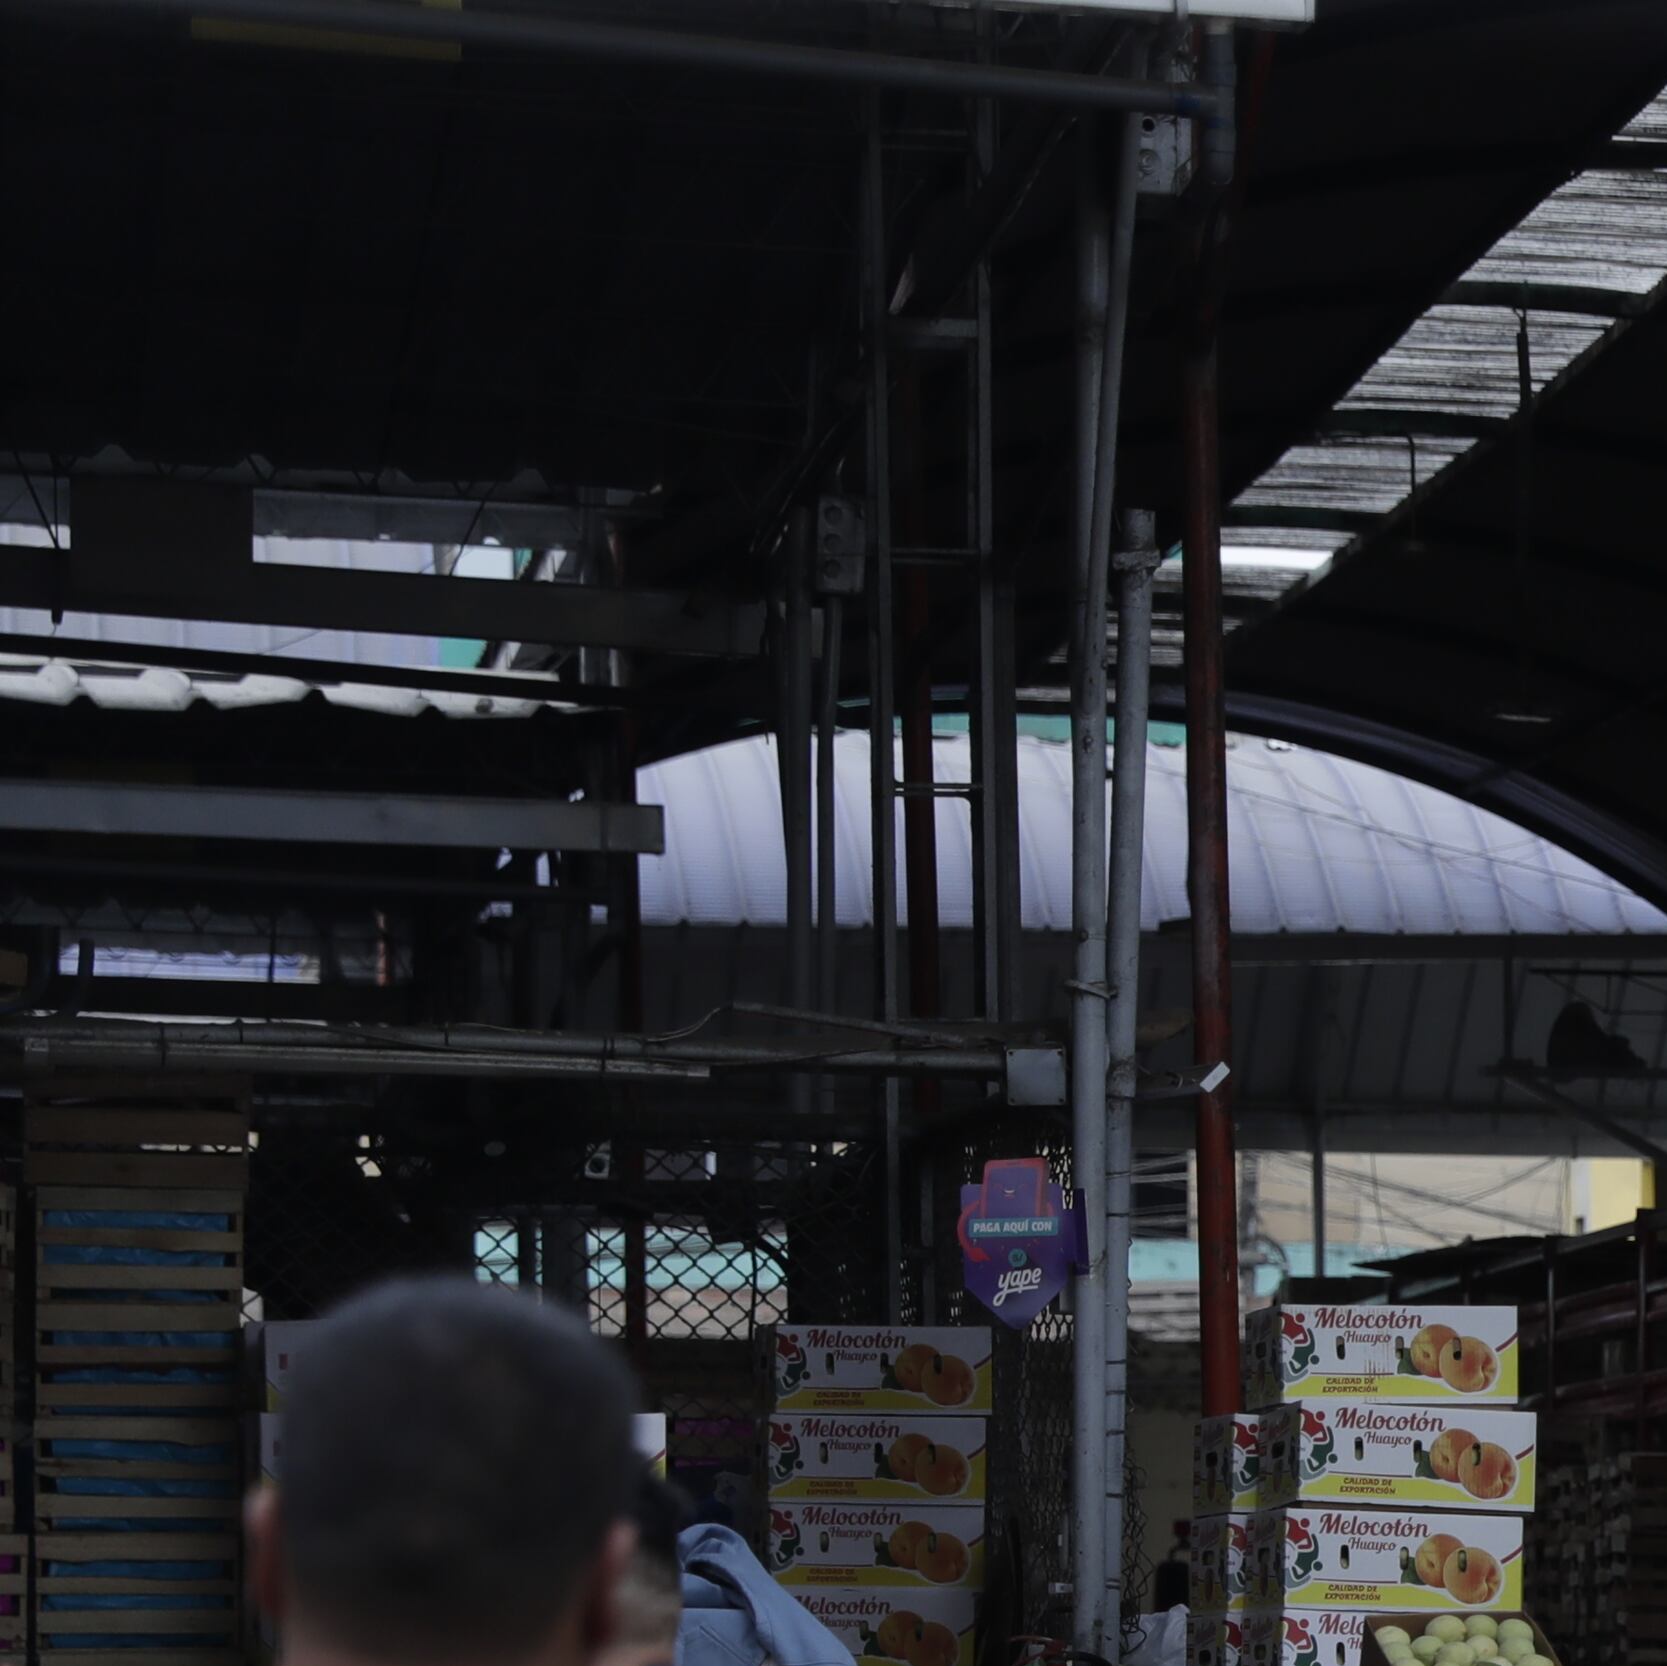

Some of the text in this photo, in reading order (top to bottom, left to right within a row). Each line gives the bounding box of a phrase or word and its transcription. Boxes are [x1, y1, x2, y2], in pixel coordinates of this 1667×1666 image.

[973, 1219, 1053, 1232] PAGA AQUÍ CON
[993, 1267, 1043, 1307] yape
[1315, 1307, 1425, 1330] Melocotón
[807, 1329, 907, 1349] Melocotón
[1344, 1330, 1392, 1347] Huayco
[833, 1349, 878, 1363] Huayco
[801, 1417, 900, 1439] Melocotón
[1335, 1407, 1446, 1432] Melocotón
[827, 1440, 872, 1454] Huayco
[1363, 1431, 1412, 1448] Huayco
[802, 1506, 902, 1527] Melocotón
[1320, 1513, 1430, 1538] Melocotón
[828, 1527, 873, 1542] Huayco
[1348, 1537, 1397, 1553] Huayco
